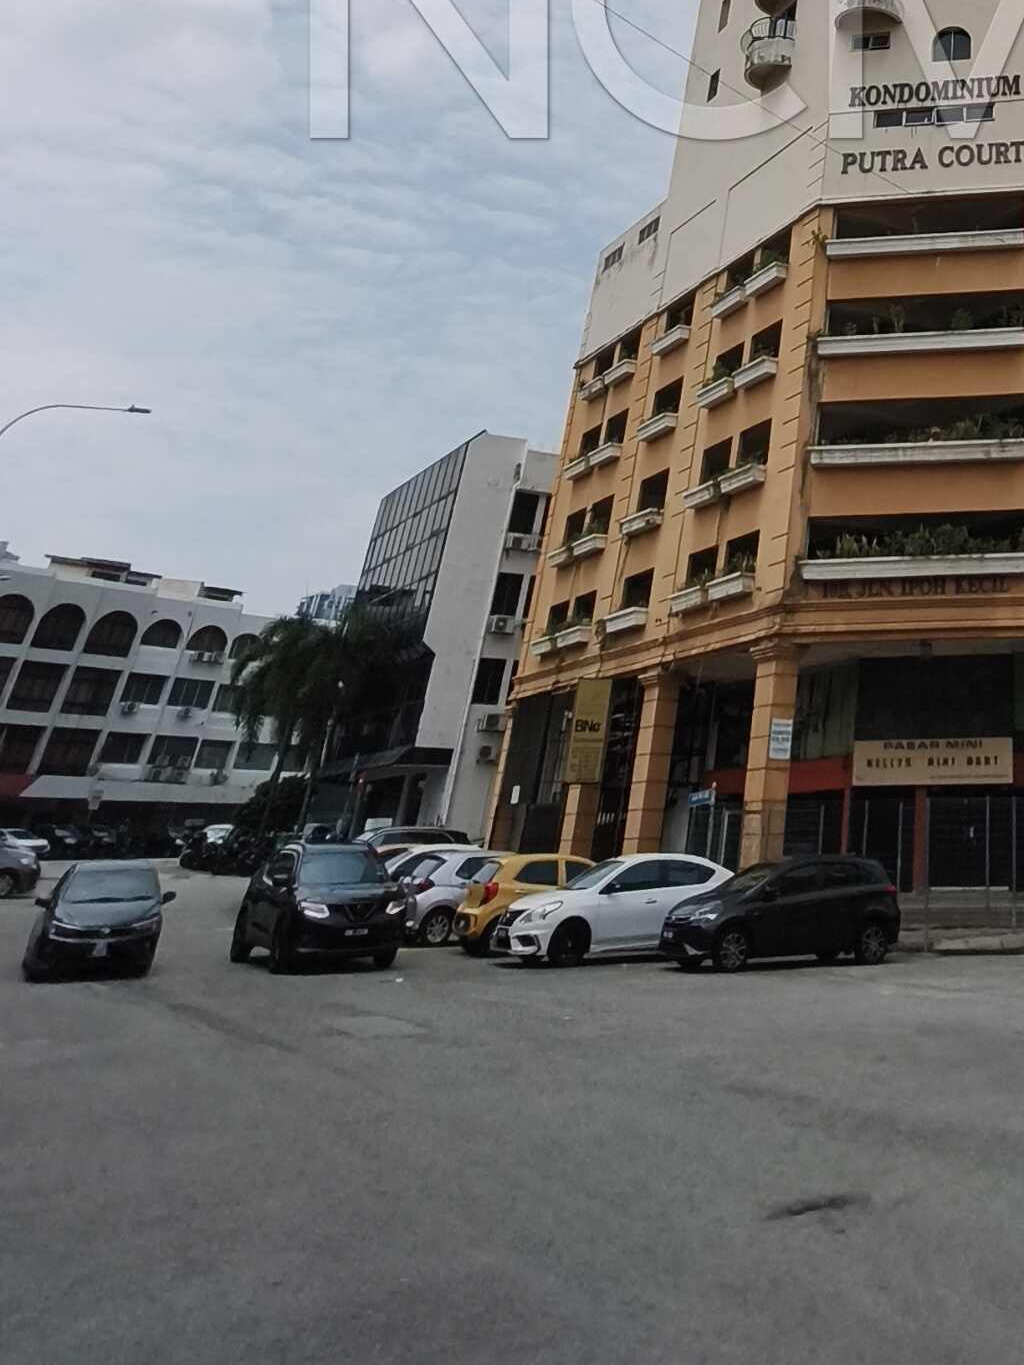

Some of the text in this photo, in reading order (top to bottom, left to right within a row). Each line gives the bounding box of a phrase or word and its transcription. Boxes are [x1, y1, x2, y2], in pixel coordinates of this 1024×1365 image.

[848, 74, 1022, 108] KONDOMINIUM
[840, 146, 929, 175] PUTRA
[902, 577, 947, 596] IPOH
[883, 738, 983, 751] PASAR MINI
